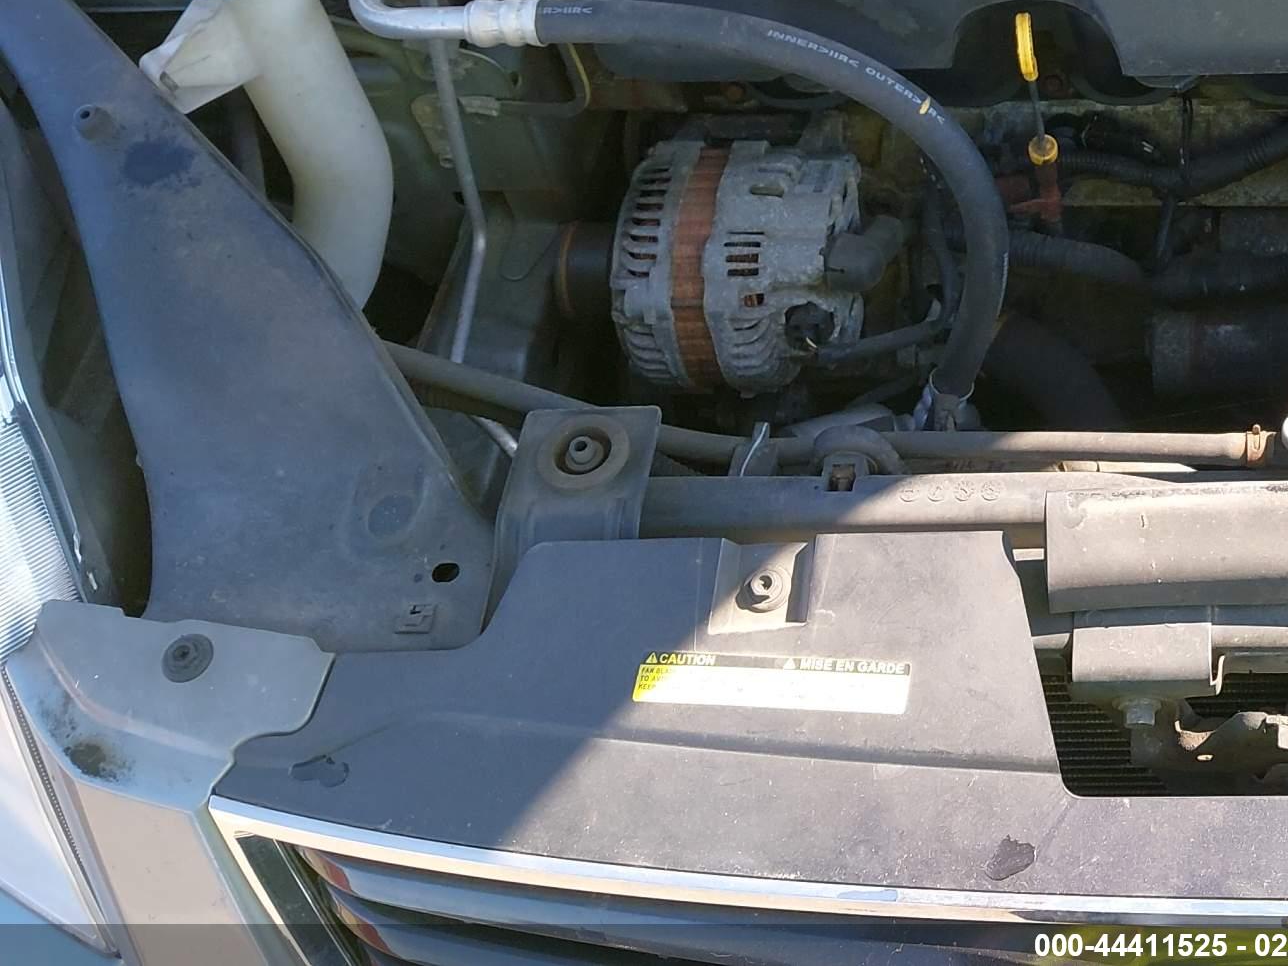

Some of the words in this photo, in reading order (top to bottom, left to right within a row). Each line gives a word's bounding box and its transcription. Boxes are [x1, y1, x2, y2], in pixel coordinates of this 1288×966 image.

[659, 653, 716, 666] CAUTION
[800, 657, 833, 671] MISE
[835, 659, 855, 672] EN
[857, 661, 905, 675] GARDE
